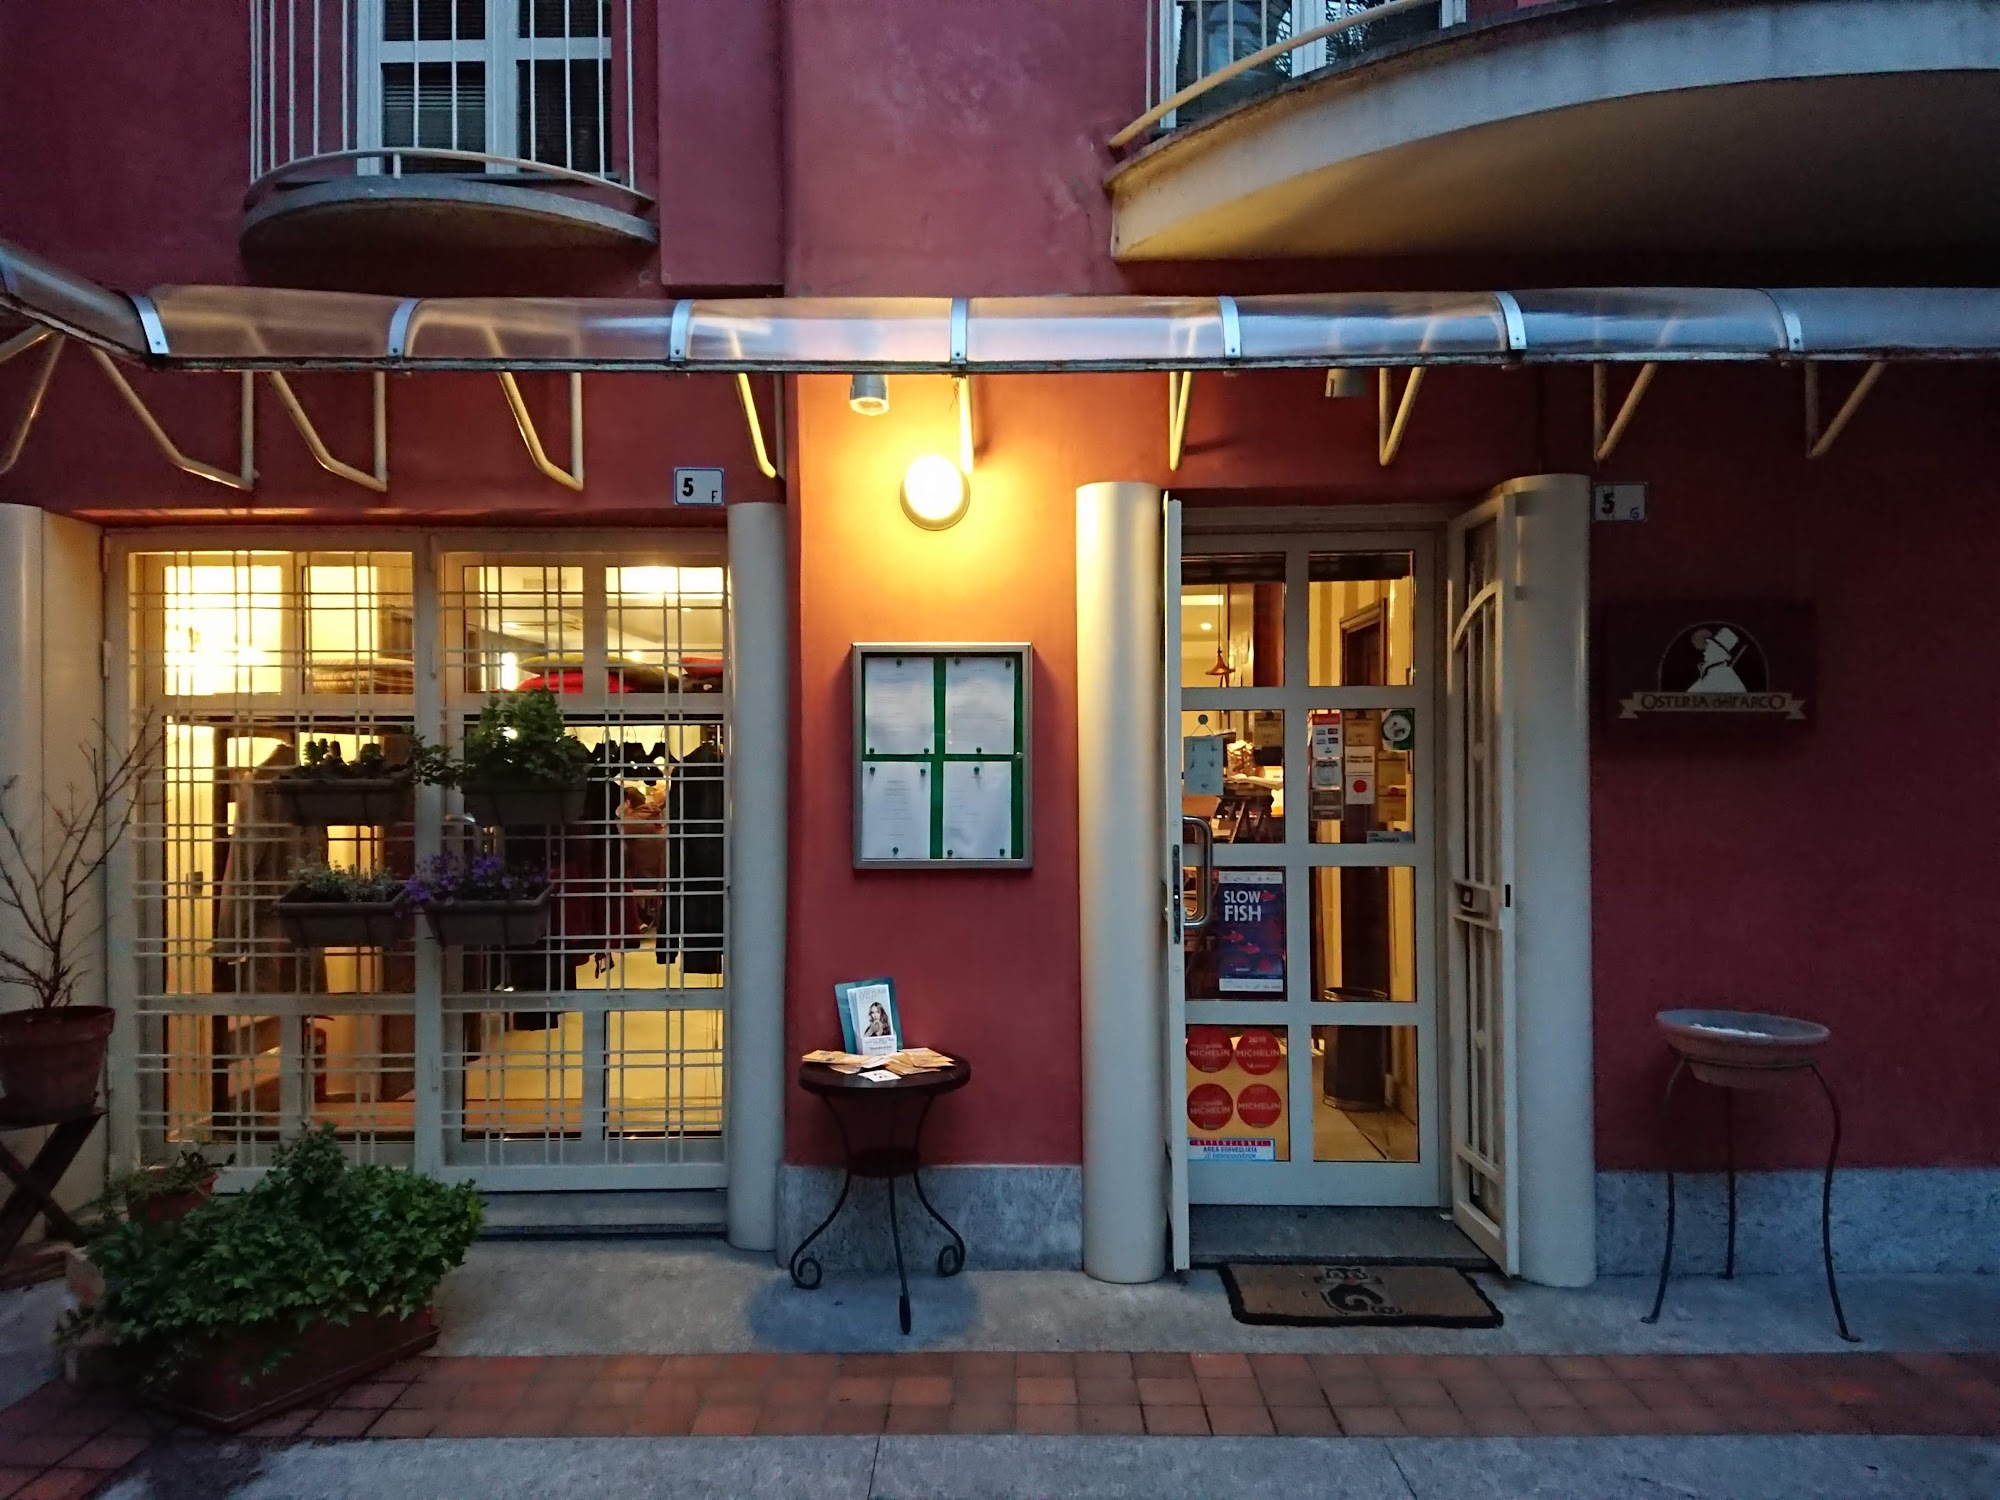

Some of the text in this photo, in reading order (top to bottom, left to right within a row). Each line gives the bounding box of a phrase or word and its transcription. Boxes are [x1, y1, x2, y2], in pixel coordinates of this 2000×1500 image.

[682, 477, 694, 497] 5
[711, 490, 718, 503] F
[1601, 492, 1615, 515] 5
[1223, 890, 1261, 904] SLOW
[1224, 904, 1262, 922] FISH
[1189, 1049, 1230, 1057] MICHELIN
[1236, 1049, 1280, 1057] MICHELIN
[1190, 1106, 1231, 1115] MICHELIN
[1238, 1102, 1280, 1111] MICHELIN
